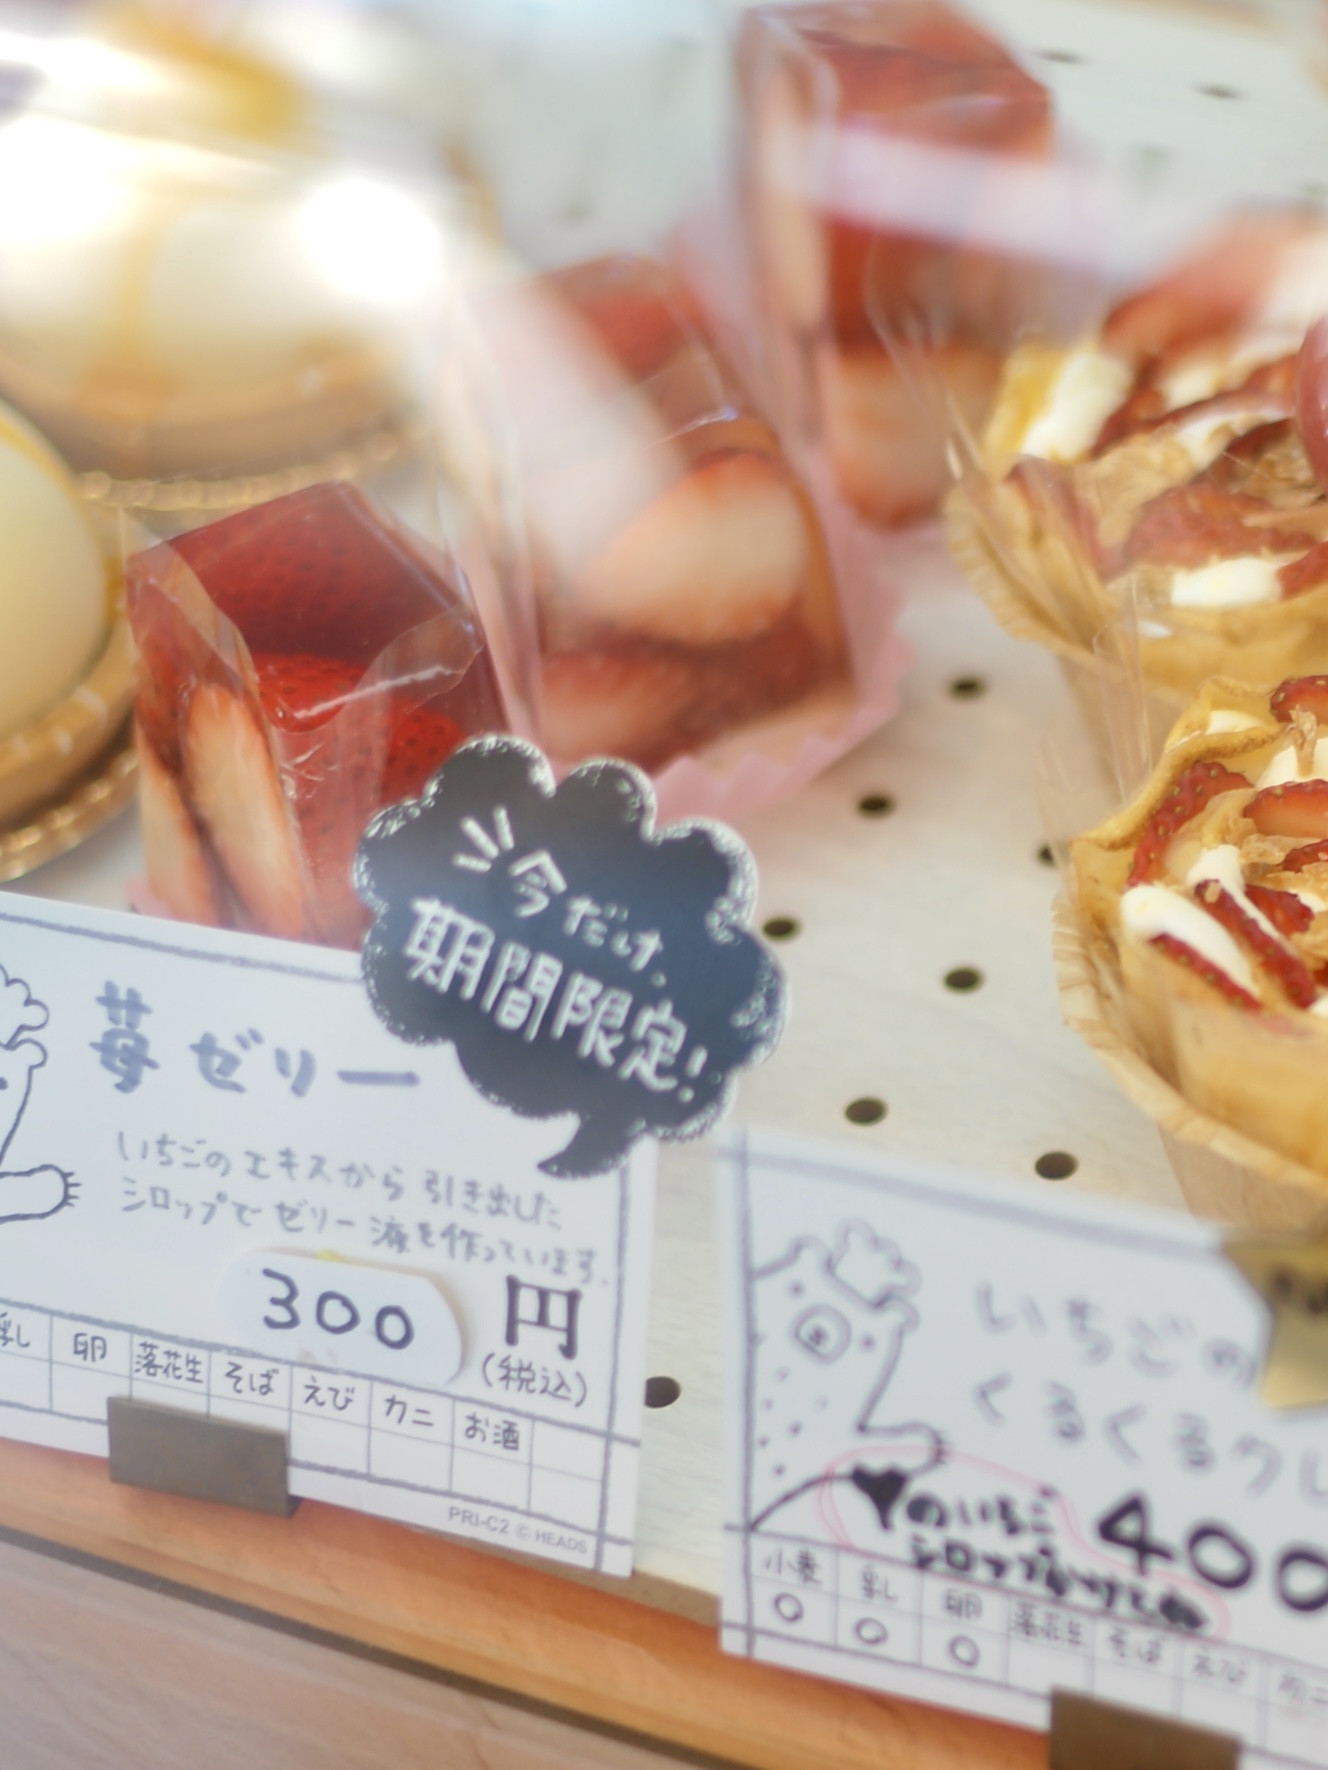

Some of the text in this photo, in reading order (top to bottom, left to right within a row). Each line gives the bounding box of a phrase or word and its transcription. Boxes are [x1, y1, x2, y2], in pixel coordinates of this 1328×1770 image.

[262, 1268, 415, 1350] 300
[505, 1274, 583, 1359] 円
[73, 1332, 108, 1362] 卵
[134, 1341, 203, 1384] 落花生
[225, 1361, 280, 1396] そば
[303, 1375, 355, 1411] えび
[385, 1395, 434, 1427] カニ
[465, 1412, 520, 1451] お酒
[482, 1352, 588, 1408] (税込)
[448, 1505, 510, 1535] PRI-C2
[535, 1527, 588, 1554] HEADS
